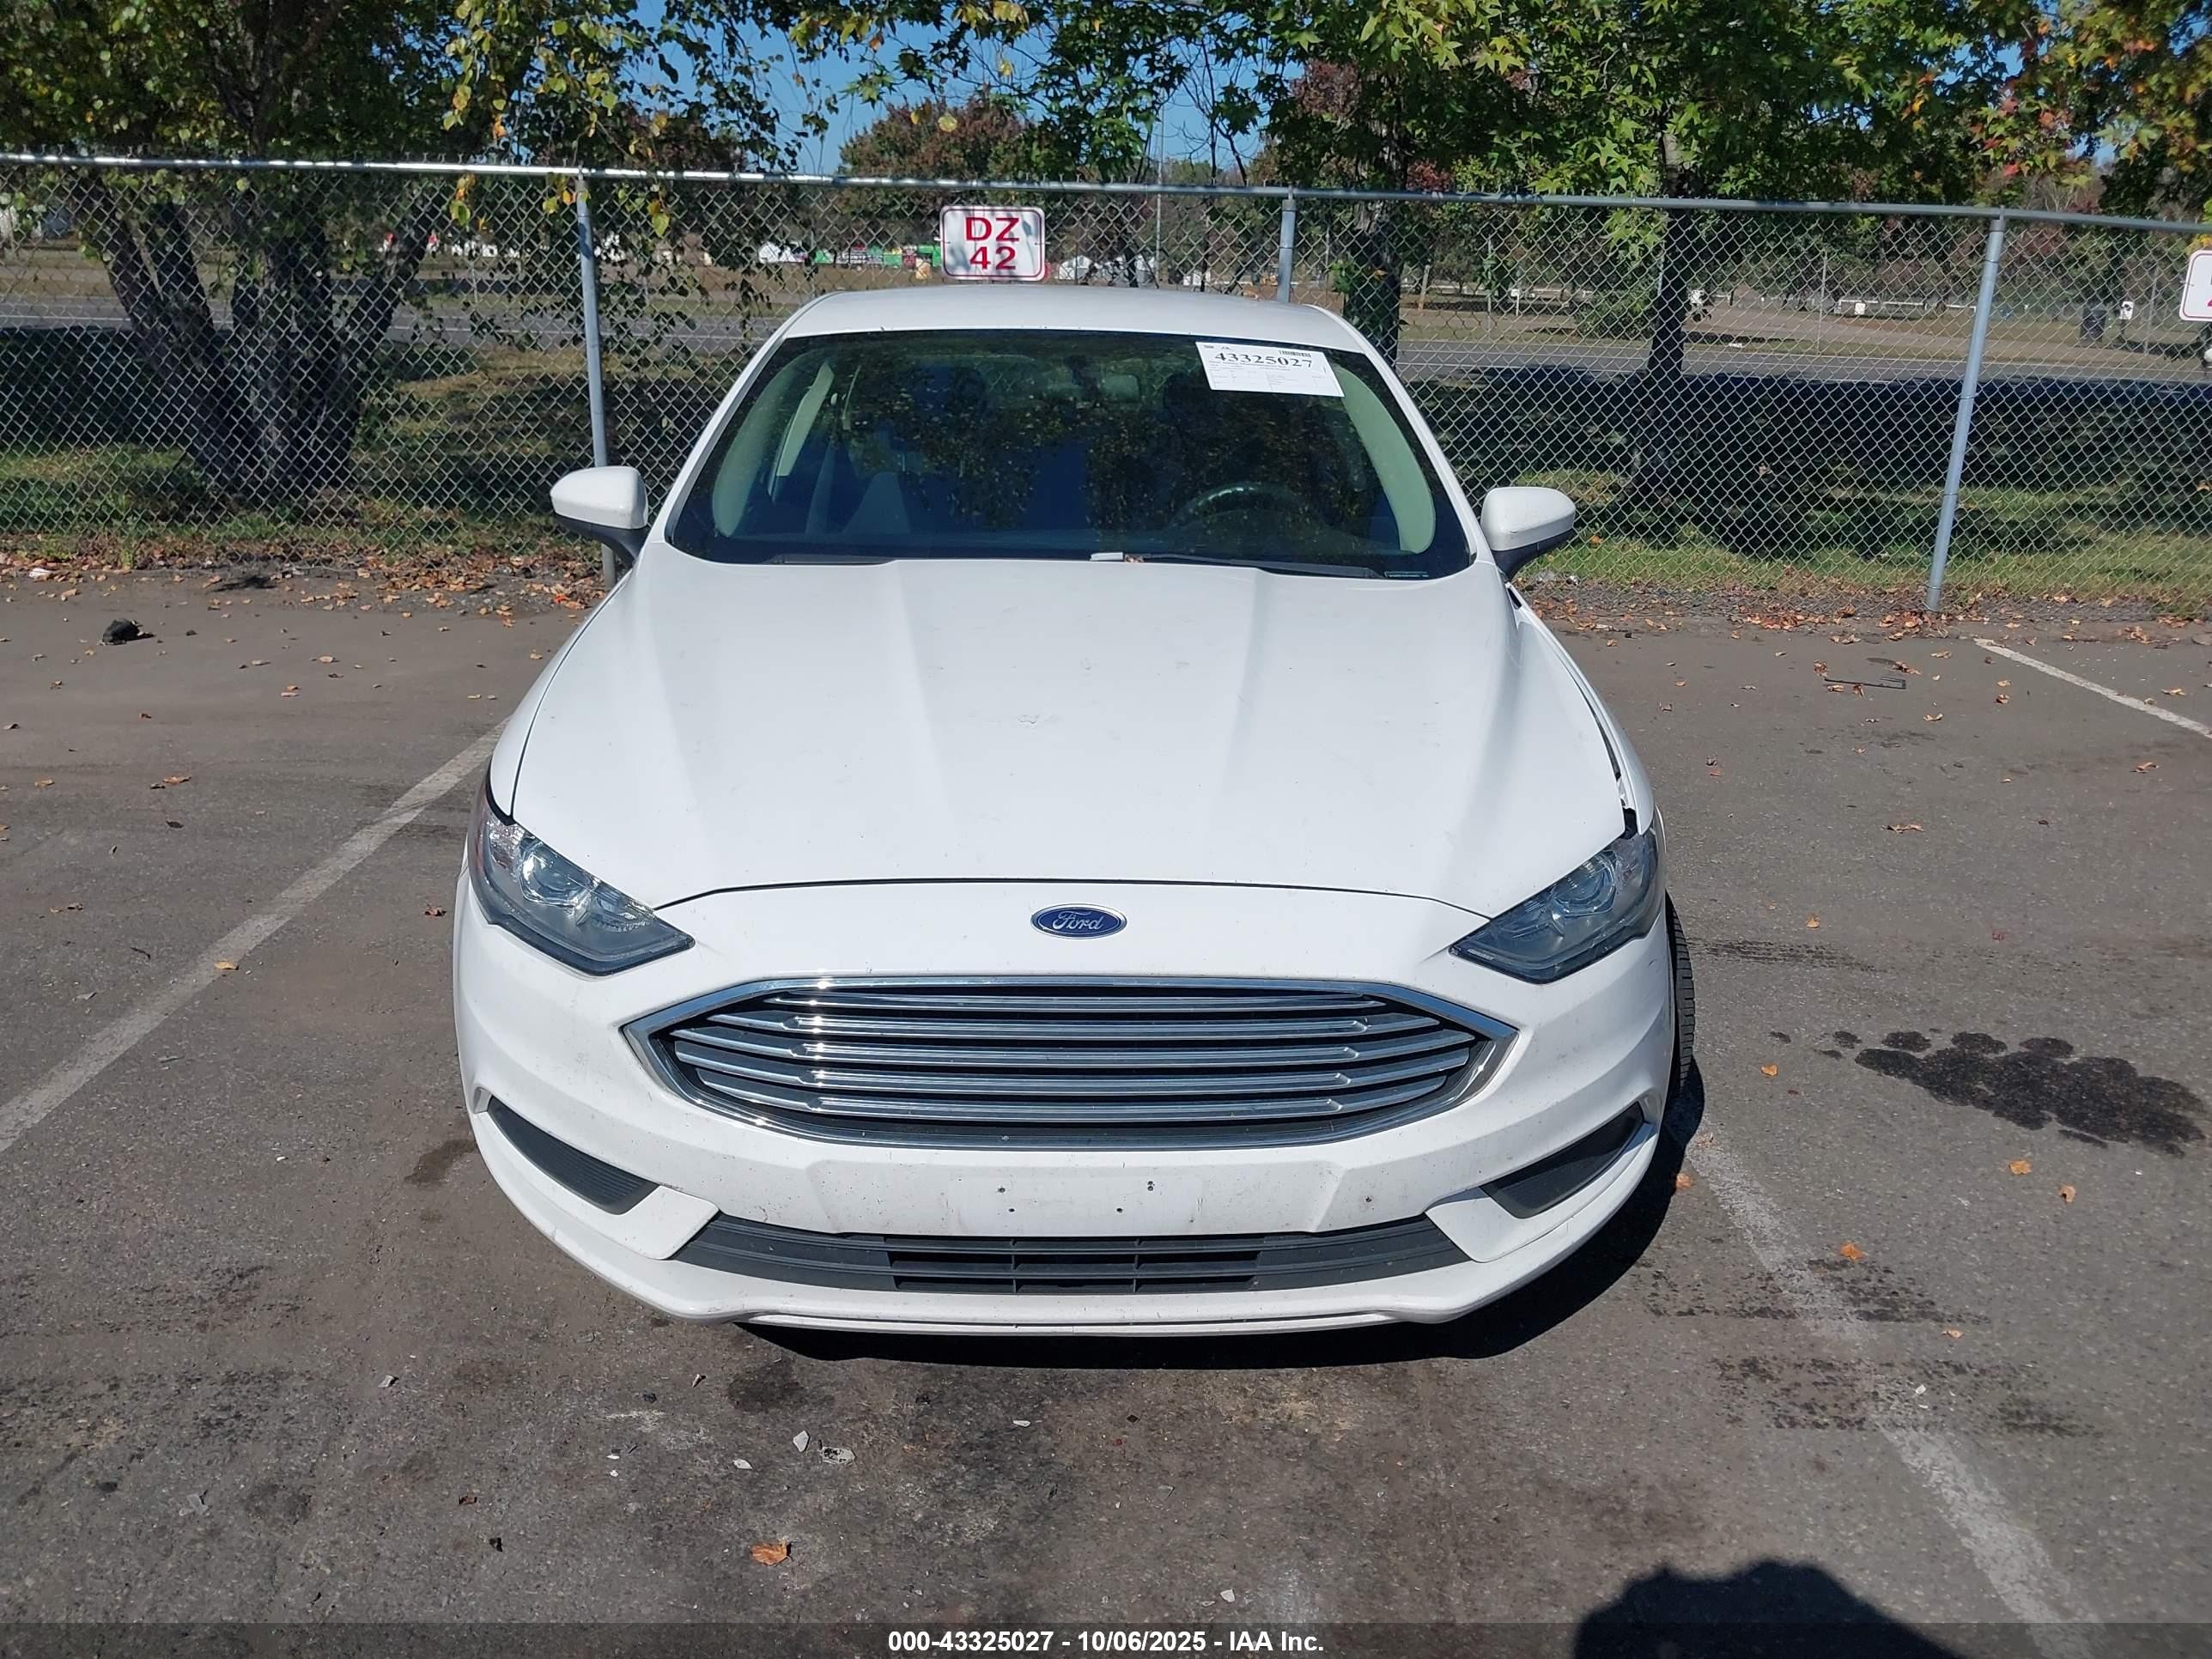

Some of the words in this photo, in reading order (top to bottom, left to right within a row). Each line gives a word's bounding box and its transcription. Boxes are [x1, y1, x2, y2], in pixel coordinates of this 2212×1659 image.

[965, 216, 1020, 241] DZ
[969, 246, 1017, 270] 42
[1214, 352, 1313, 368] 43325027
[1053, 910, 1104, 930] Ford
